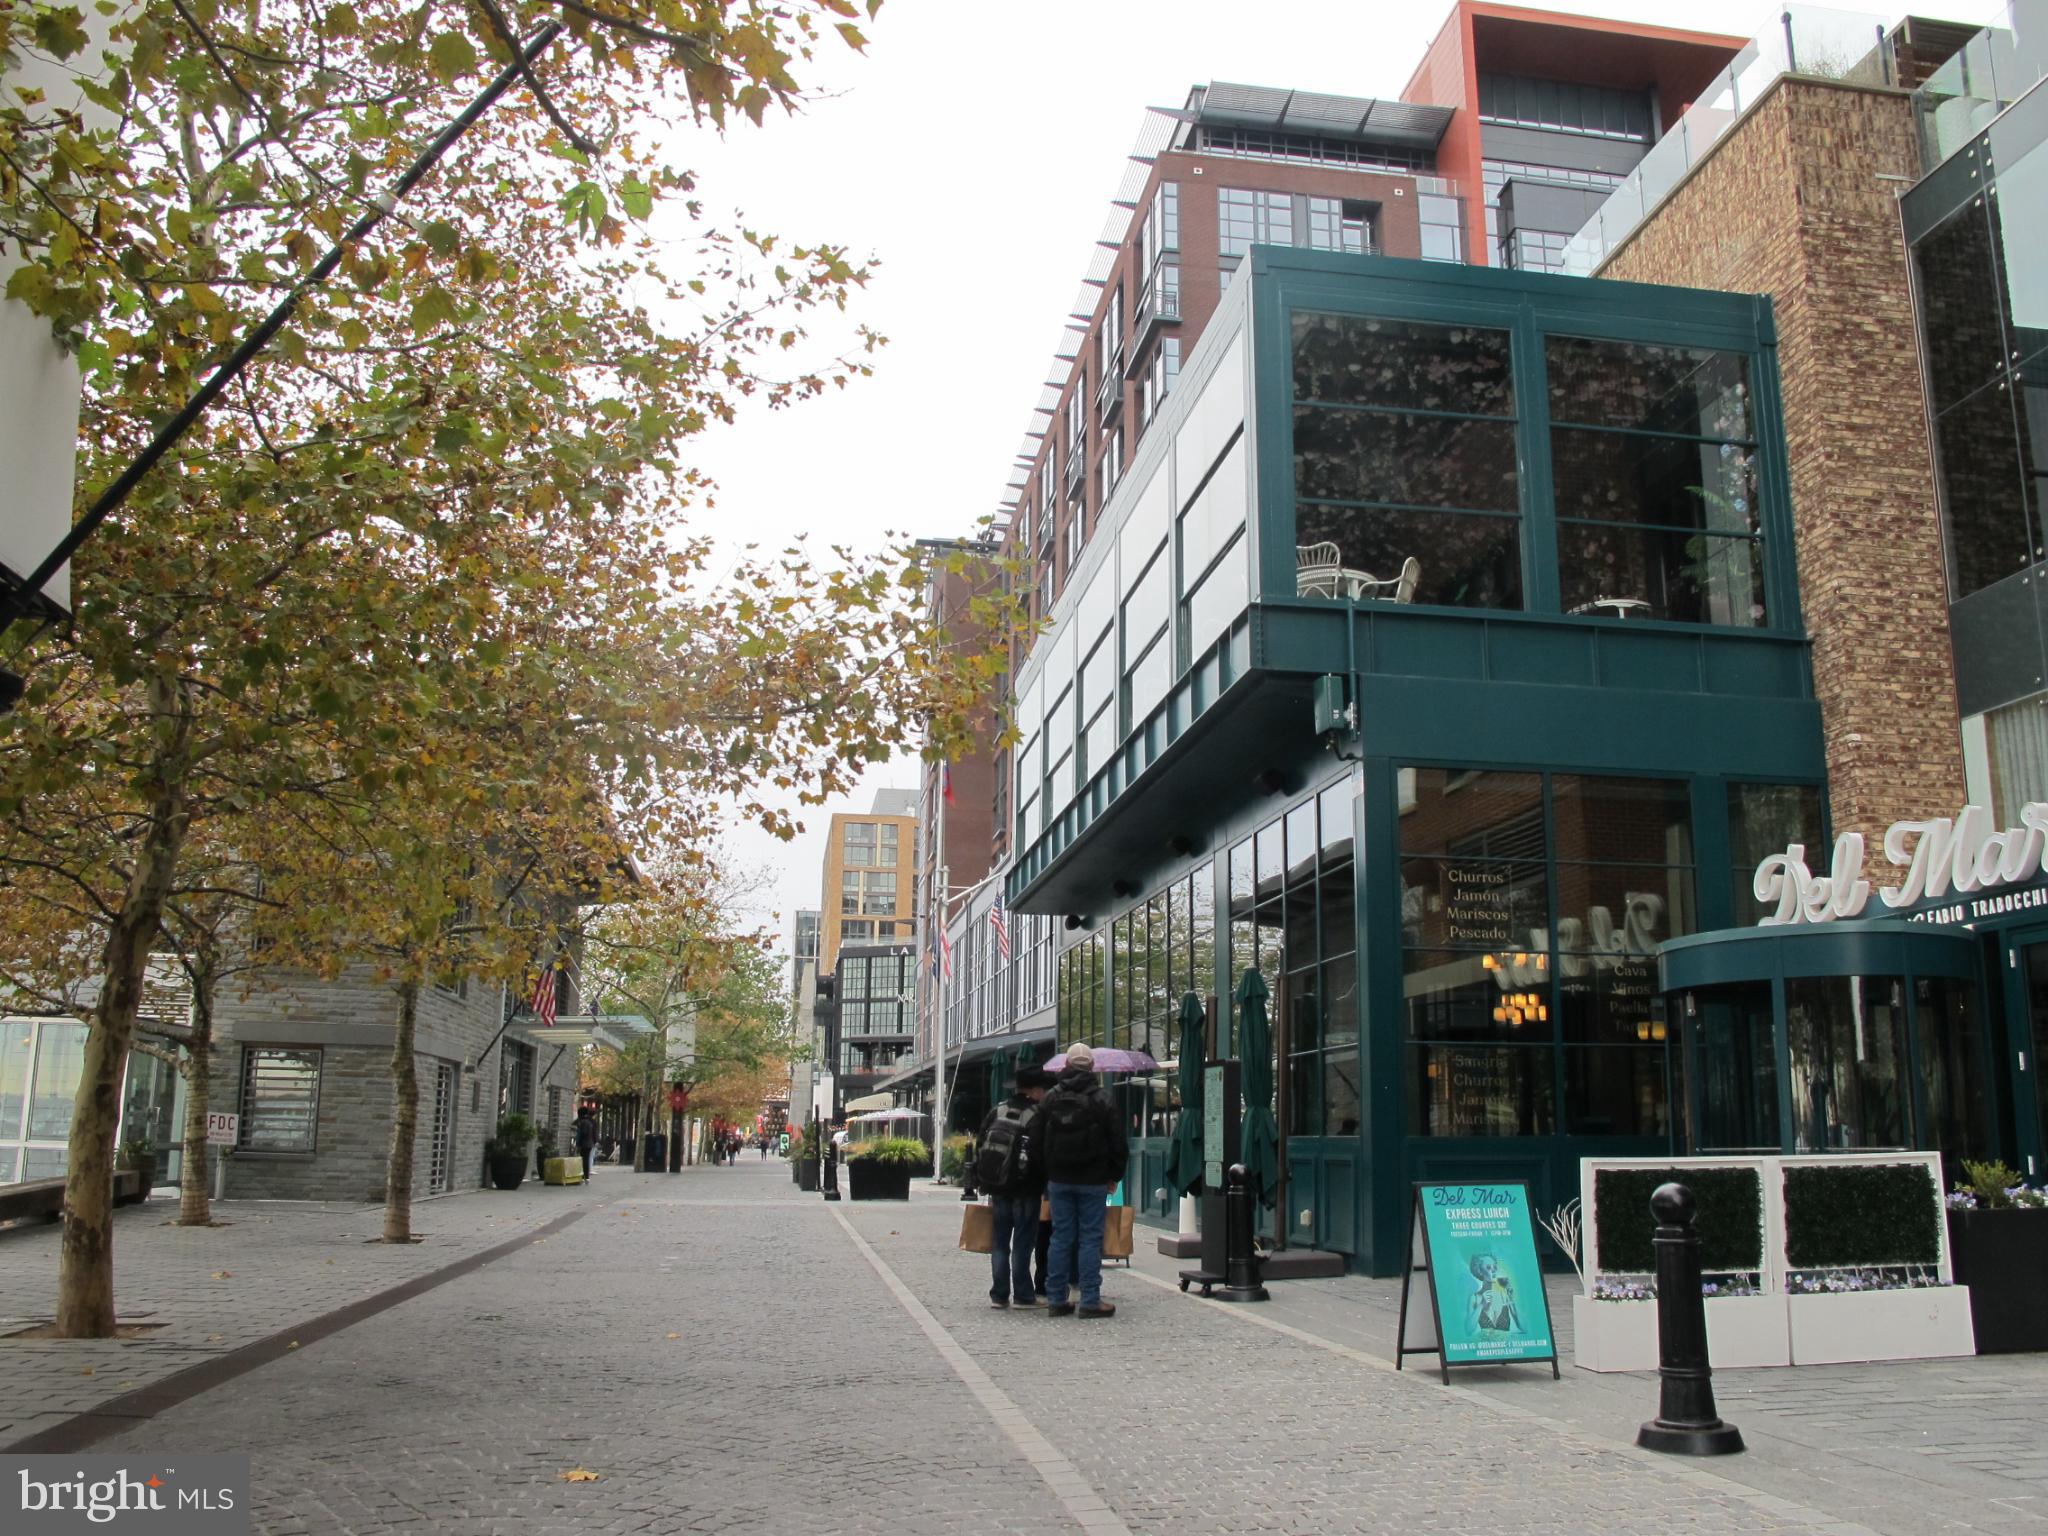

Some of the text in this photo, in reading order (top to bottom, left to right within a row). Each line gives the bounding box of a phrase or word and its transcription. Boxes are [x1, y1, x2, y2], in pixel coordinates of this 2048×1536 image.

[1447, 869, 1504, 884] Churros
[1753, 832, 1870, 927] Del
[1453, 887, 1500, 902] Jamón
[1447, 906, 1508, 920] Mariscos
[1926, 888, 2048, 924] FABIO TRABOCCHI
[1449, 924, 1506, 939] Pescado
[1614, 963, 1648, 976] Cava
[1612, 981, 1650, 995] Vinos
[1609, 1000, 1649, 1013] Paella
[209, 1114, 235, 1131] FDC
[1432, 1186, 1517, 1206] Del Mar
[1445, 1207, 1510, 1220] EXPRESS LUNCH
